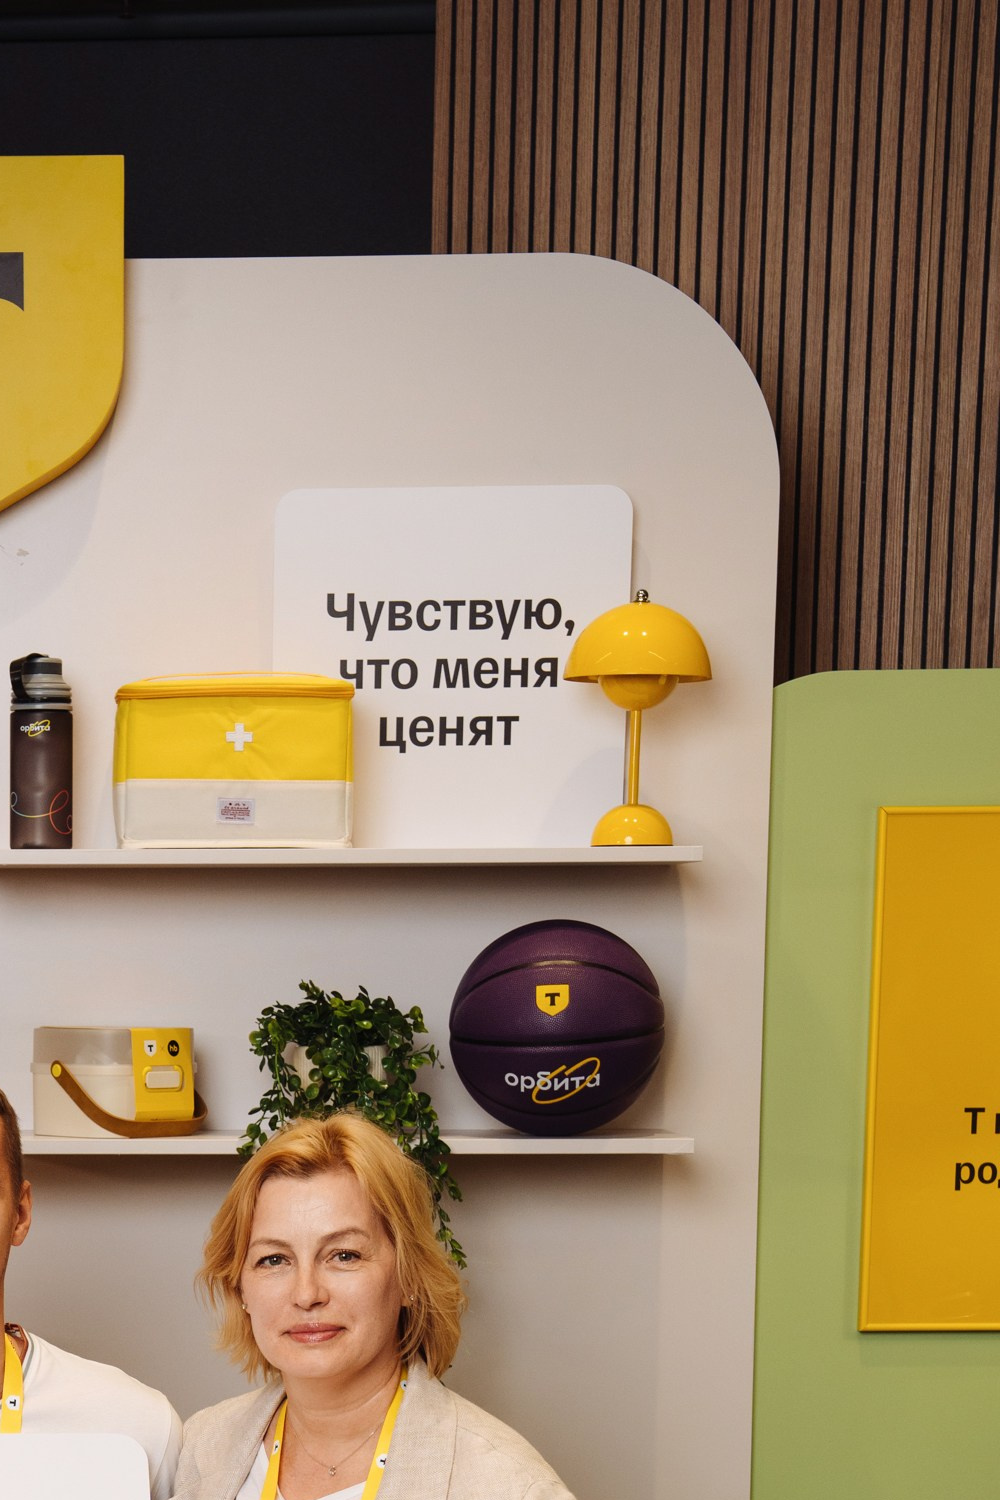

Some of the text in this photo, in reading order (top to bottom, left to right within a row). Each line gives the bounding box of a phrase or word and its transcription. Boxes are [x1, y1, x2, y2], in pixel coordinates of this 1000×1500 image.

[326, 593, 576, 642] Чувствую,
[339, 656, 559, 690] что меня
[20, 720, 51, 735] орбита
[379, 715, 520, 754] ценят
[504, 1067, 601, 1097] орбита
[954, 1161, 1000, 1191] ро
